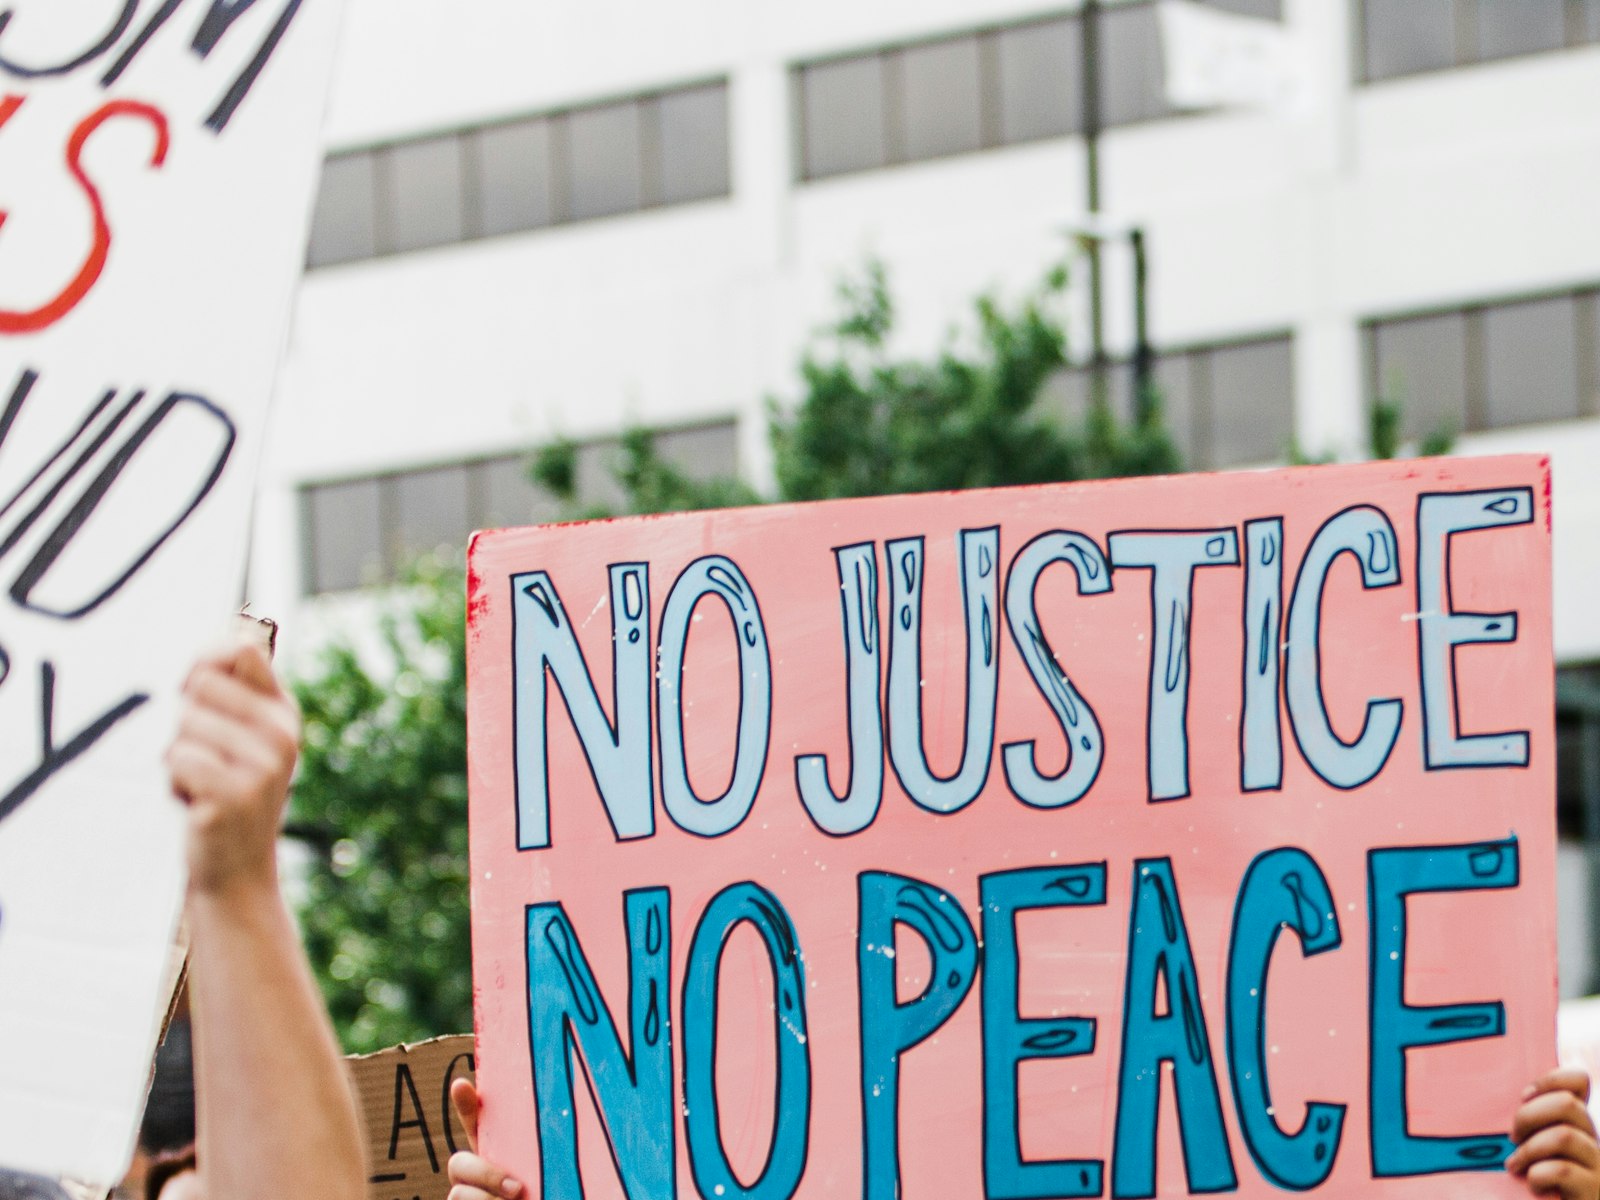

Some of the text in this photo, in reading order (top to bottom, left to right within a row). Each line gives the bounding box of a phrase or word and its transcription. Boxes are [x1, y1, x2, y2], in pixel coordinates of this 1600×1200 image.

[0, 646, 150, 822] Y
[511, 486, 1535, 851] NO JUSTICE
